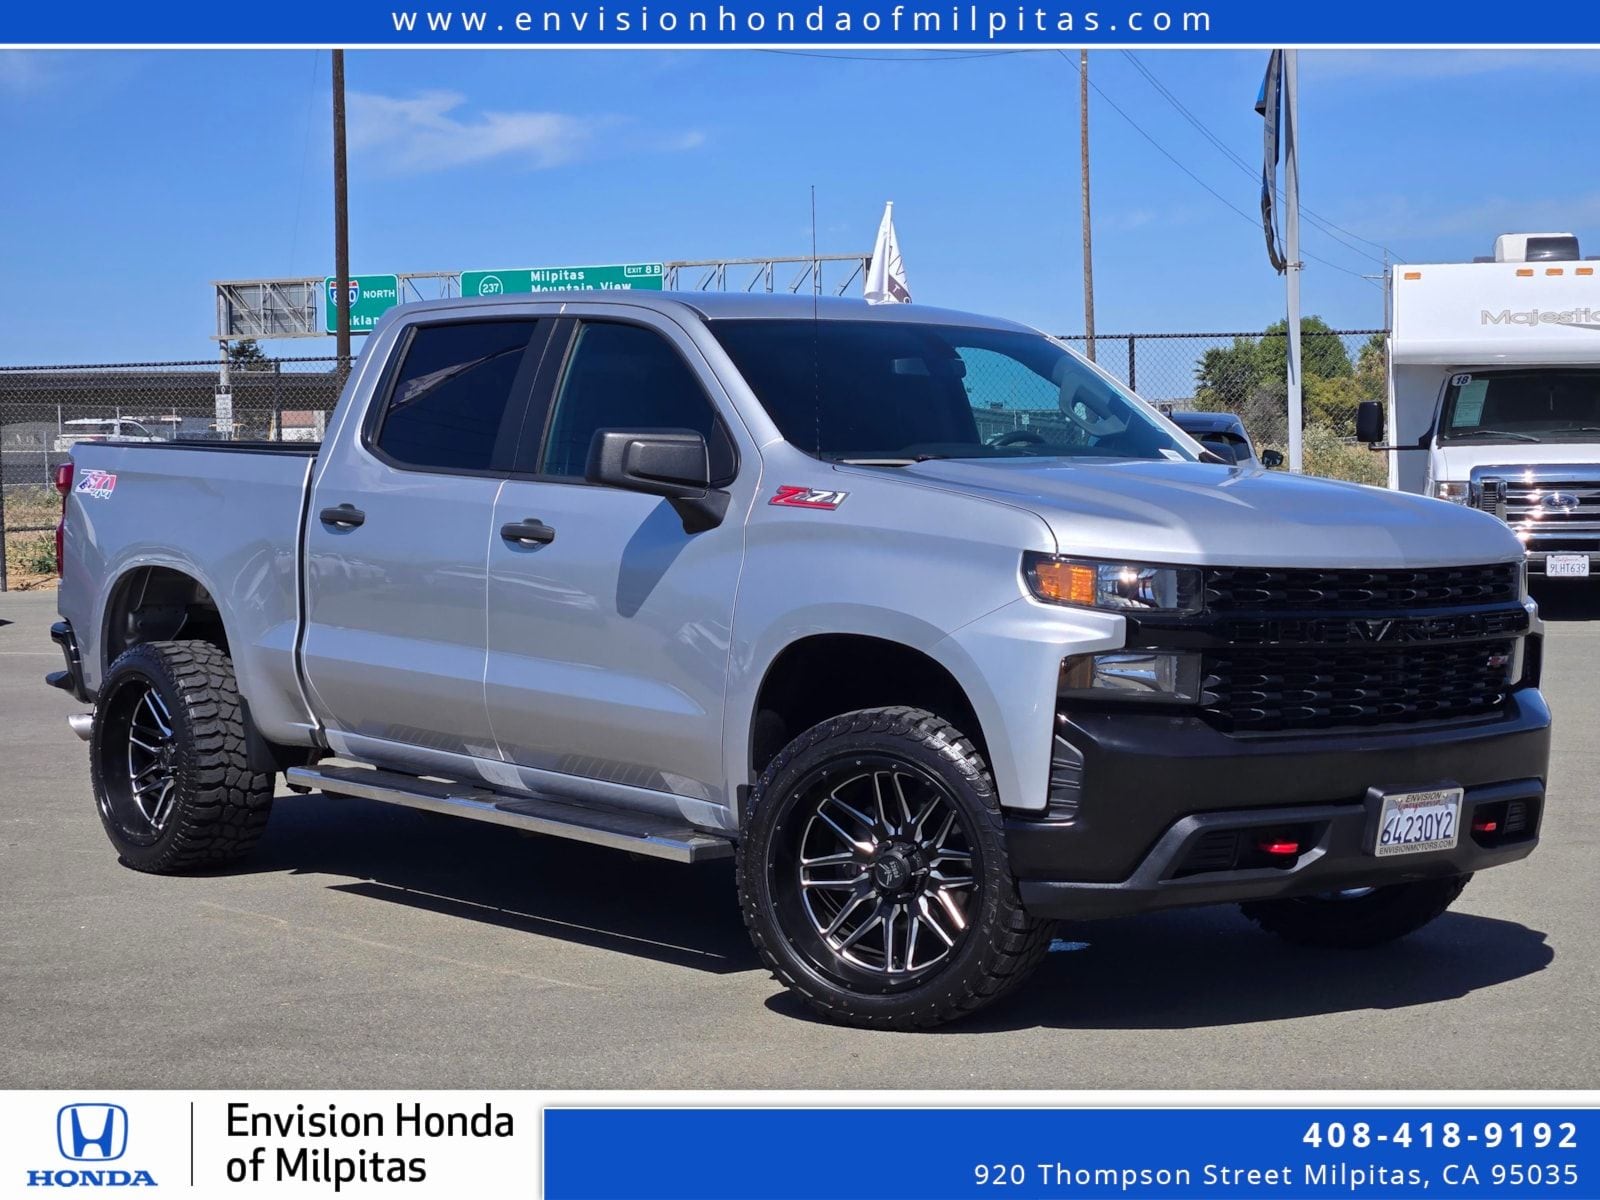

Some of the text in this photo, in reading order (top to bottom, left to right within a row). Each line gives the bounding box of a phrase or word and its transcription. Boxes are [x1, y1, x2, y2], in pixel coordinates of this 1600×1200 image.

[530, 269, 585, 283] Milpitas
[363, 289, 395, 299] NORTH
[482, 283, 499, 293] 237
[332, 289, 356, 303] 80
[1456, 376, 1470, 385] 18
[769, 485, 849, 510] Z71
[1406, 792, 1441, 803] ENVISION
[1381, 811, 1453, 844] 64230Y2
[1379, 840, 1454, 855] ENVISIONMOTORS.COM
